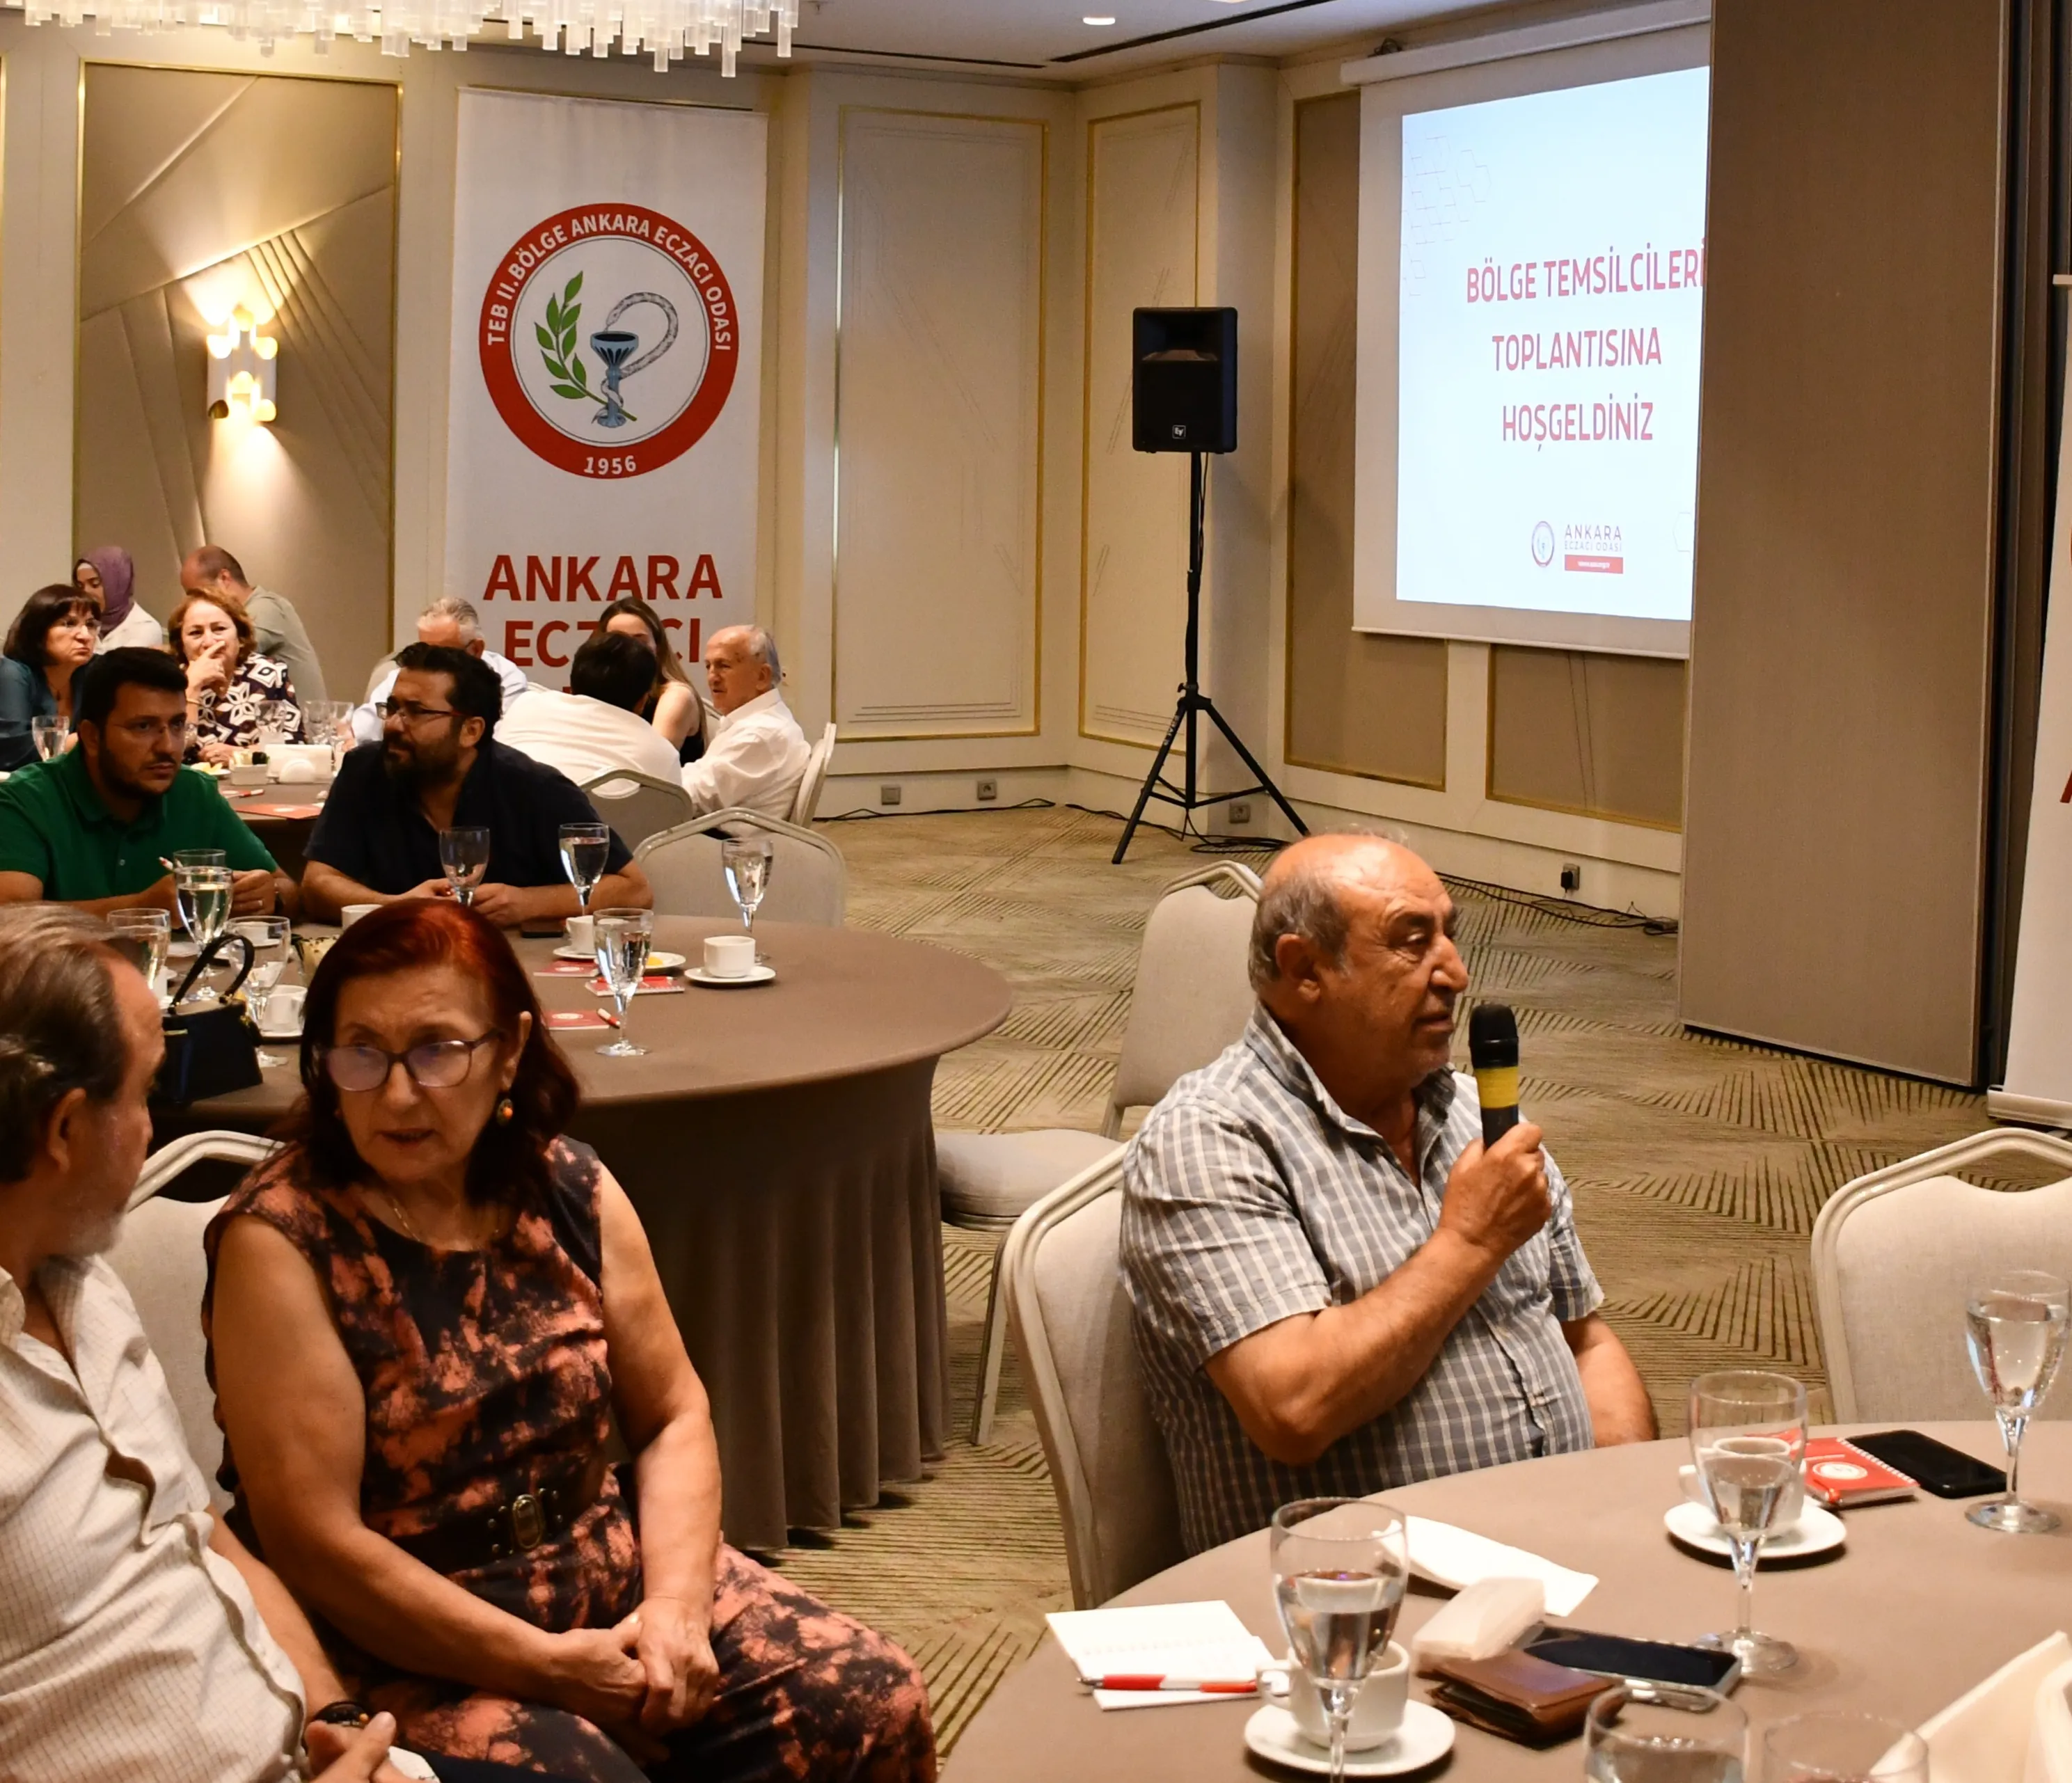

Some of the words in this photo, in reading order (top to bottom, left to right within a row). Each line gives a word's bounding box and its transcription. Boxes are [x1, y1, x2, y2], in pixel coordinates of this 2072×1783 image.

[488, 304, 509, 345] TEB
[571, 214, 649, 237] ANKARA
[653, 225, 714, 284] ECZACI
[705, 286, 731, 351] ODASI
[1466, 256, 1537, 303] BÖLGE
[1492, 326, 1662, 372] TOPLANTISINA
[1503, 393, 1653, 452] HOŞGELDİNİZ
[583, 455, 637, 475] 1956
[1564, 523, 1622, 541] ANKARA
[1595, 541, 1622, 552] ODASI
[483, 554, 723, 602] ANKARA
